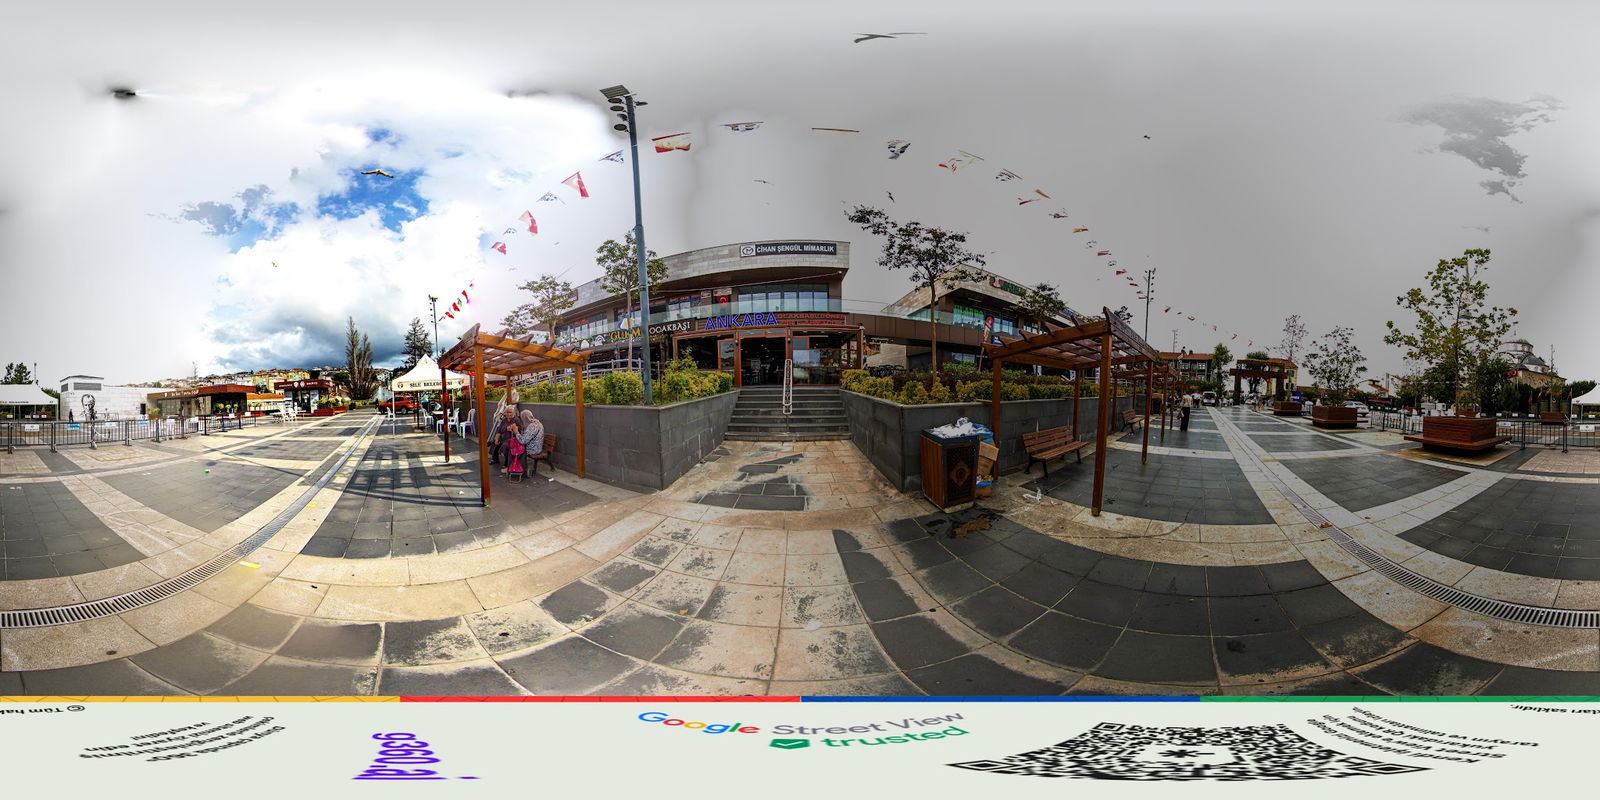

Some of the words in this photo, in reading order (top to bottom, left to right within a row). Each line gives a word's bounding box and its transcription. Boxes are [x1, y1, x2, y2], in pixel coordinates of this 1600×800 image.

[777, 244, 802, 252] ŞENGÜL
[704, 312, 778, 330] ANKARA
[649, 322, 690, 334] OCAKBAŞI
